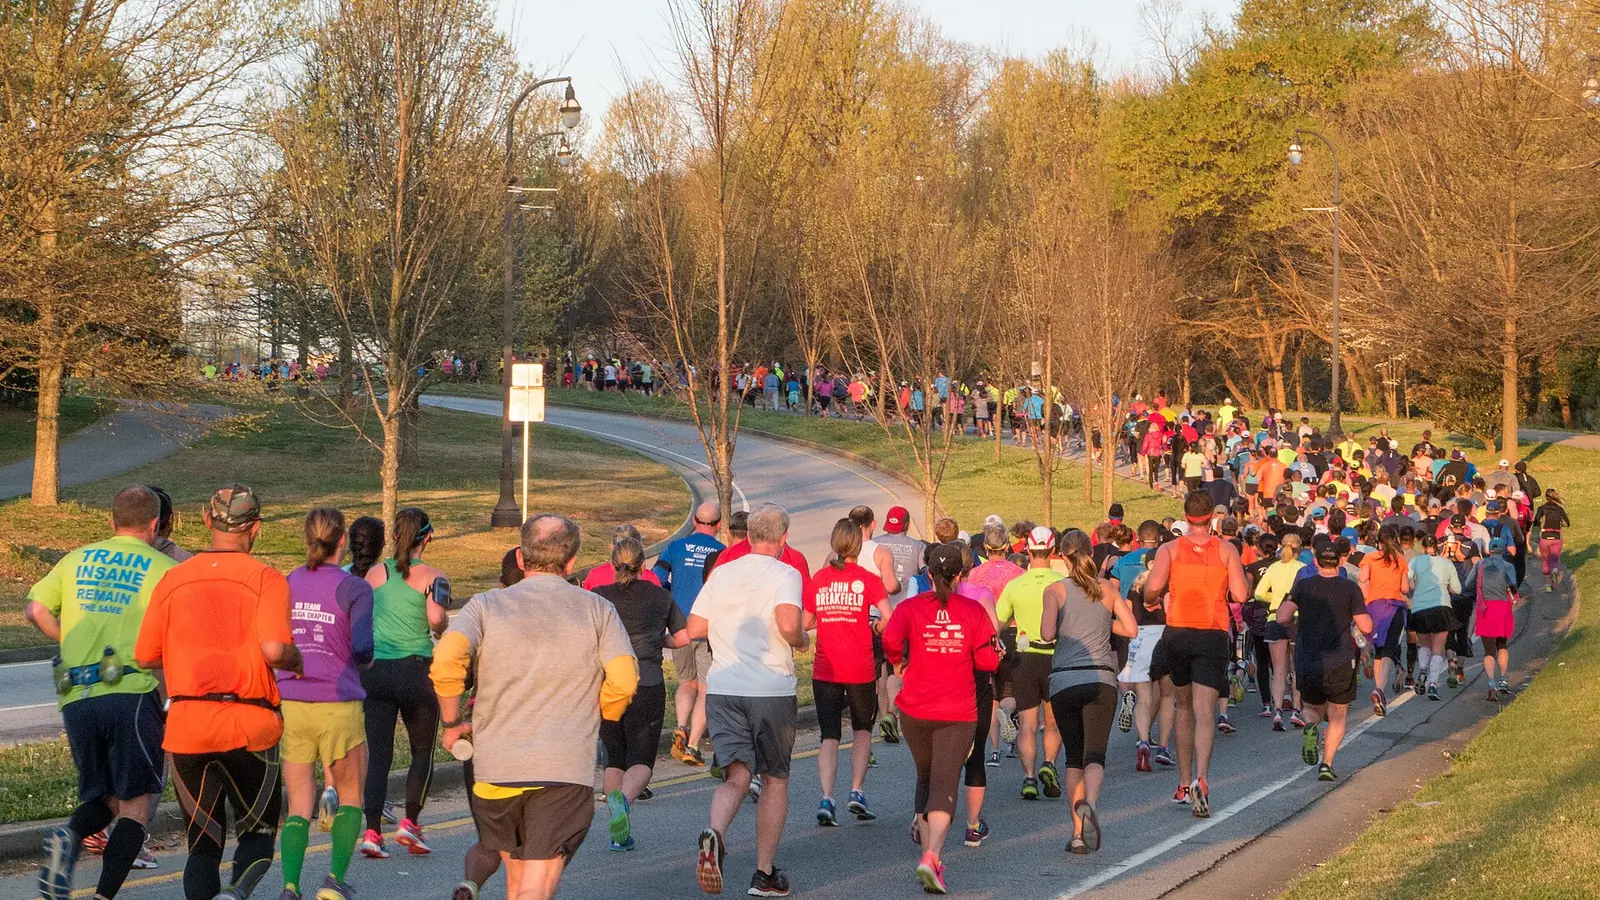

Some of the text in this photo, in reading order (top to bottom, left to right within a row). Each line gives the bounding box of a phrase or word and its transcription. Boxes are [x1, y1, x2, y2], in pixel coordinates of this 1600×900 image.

[82, 548, 152, 571] TRAIN
[76, 565, 146, 587] INSANE
[829, 581, 849, 593] JOHN
[77, 588, 132, 605] REMAIN
[816, 592, 864, 607] BREAKFIELD
[80, 603, 123, 615] THE SAME
[306, 611, 333, 622] CHAPTER
